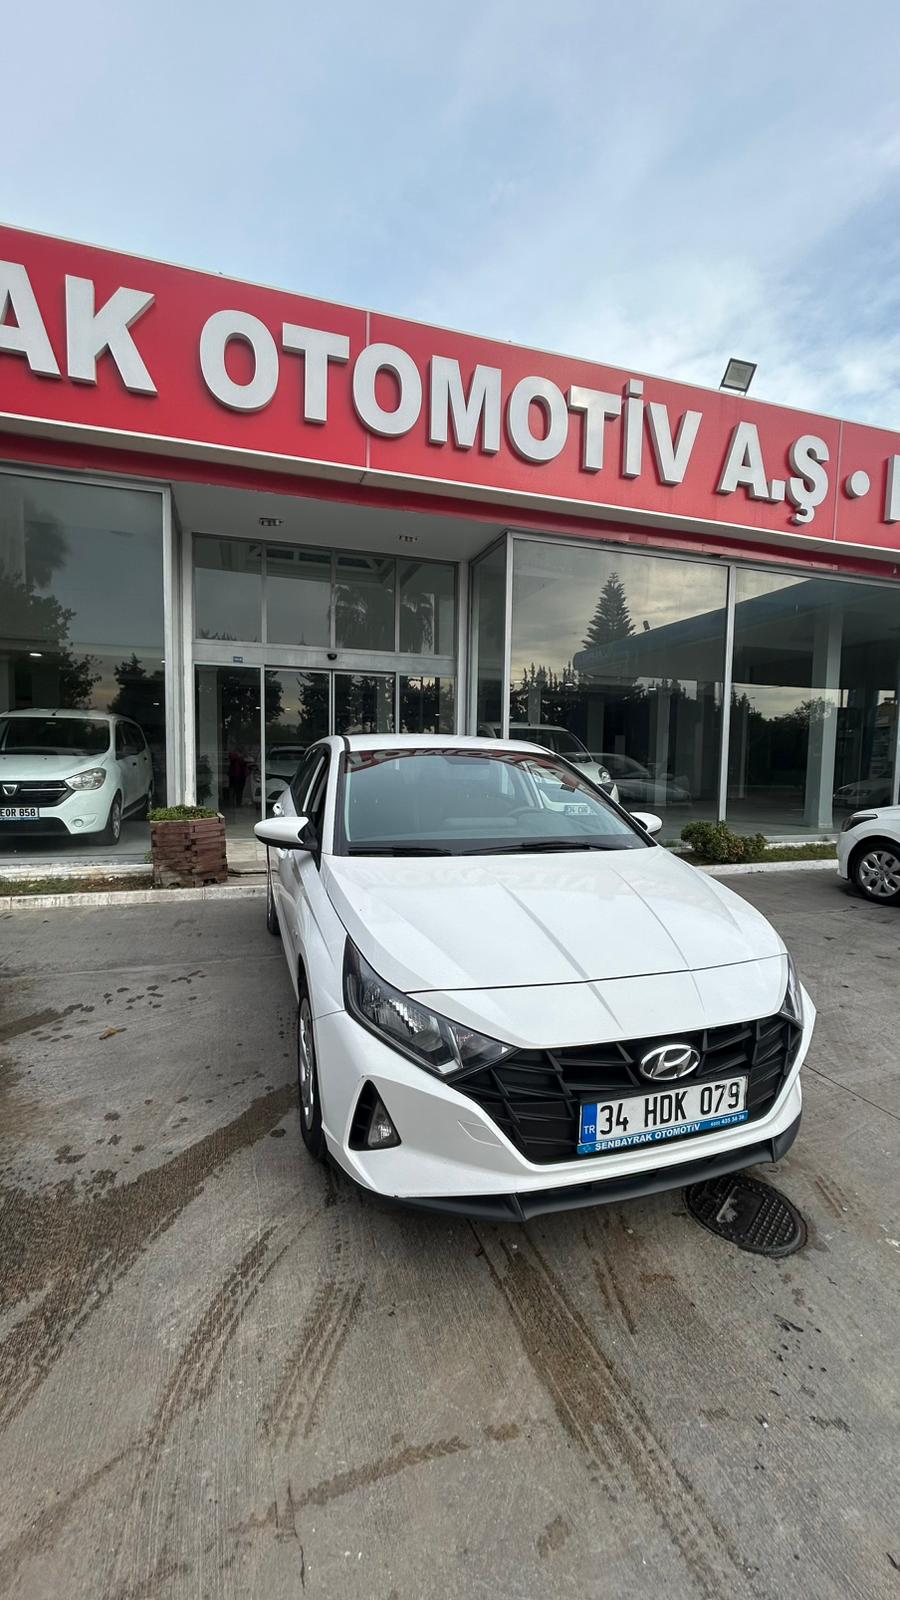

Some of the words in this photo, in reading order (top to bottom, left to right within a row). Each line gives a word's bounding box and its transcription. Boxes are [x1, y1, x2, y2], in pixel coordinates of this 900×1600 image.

[199, 310, 702, 485] OTOMOTİV
[716, 421, 830, 526] A.Ş
[19, 808, 36, 817] 858
[583, 1124, 596, 1135] TR
[599, 1102, 629, 1135] 34
[644, 1090, 688, 1128] HDK
[700, 1082, 740, 1115] 079
